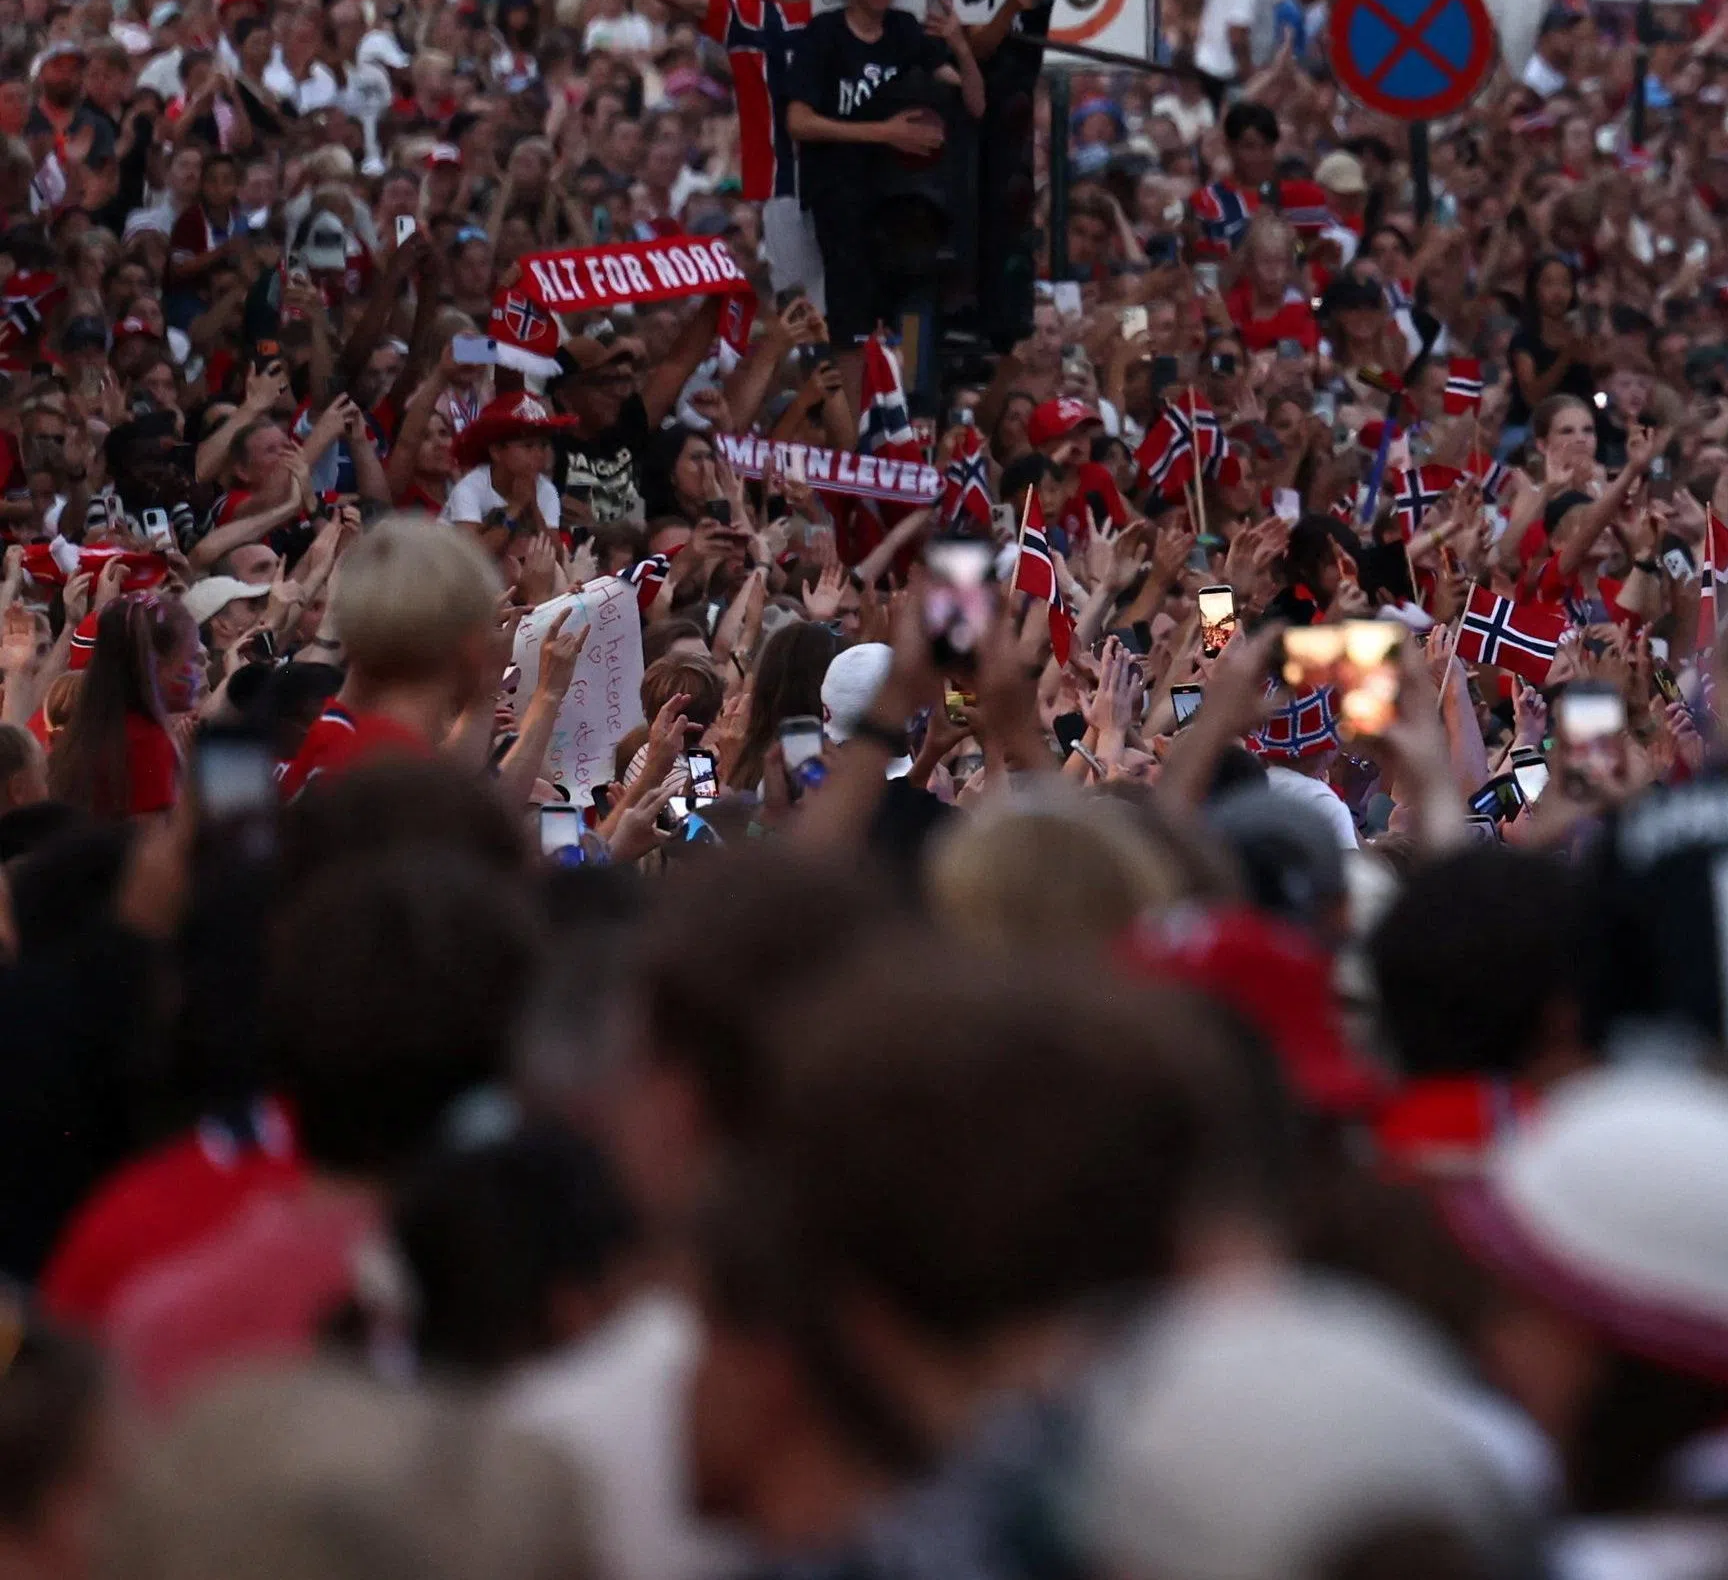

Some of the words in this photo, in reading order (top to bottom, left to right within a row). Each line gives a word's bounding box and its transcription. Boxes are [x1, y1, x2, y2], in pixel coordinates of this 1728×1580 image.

[530, 257, 584, 303] ALT
[584, 254, 653, 298] FOR
[646, 238, 746, 289] NORG
[839, 451, 941, 495] LEVER
